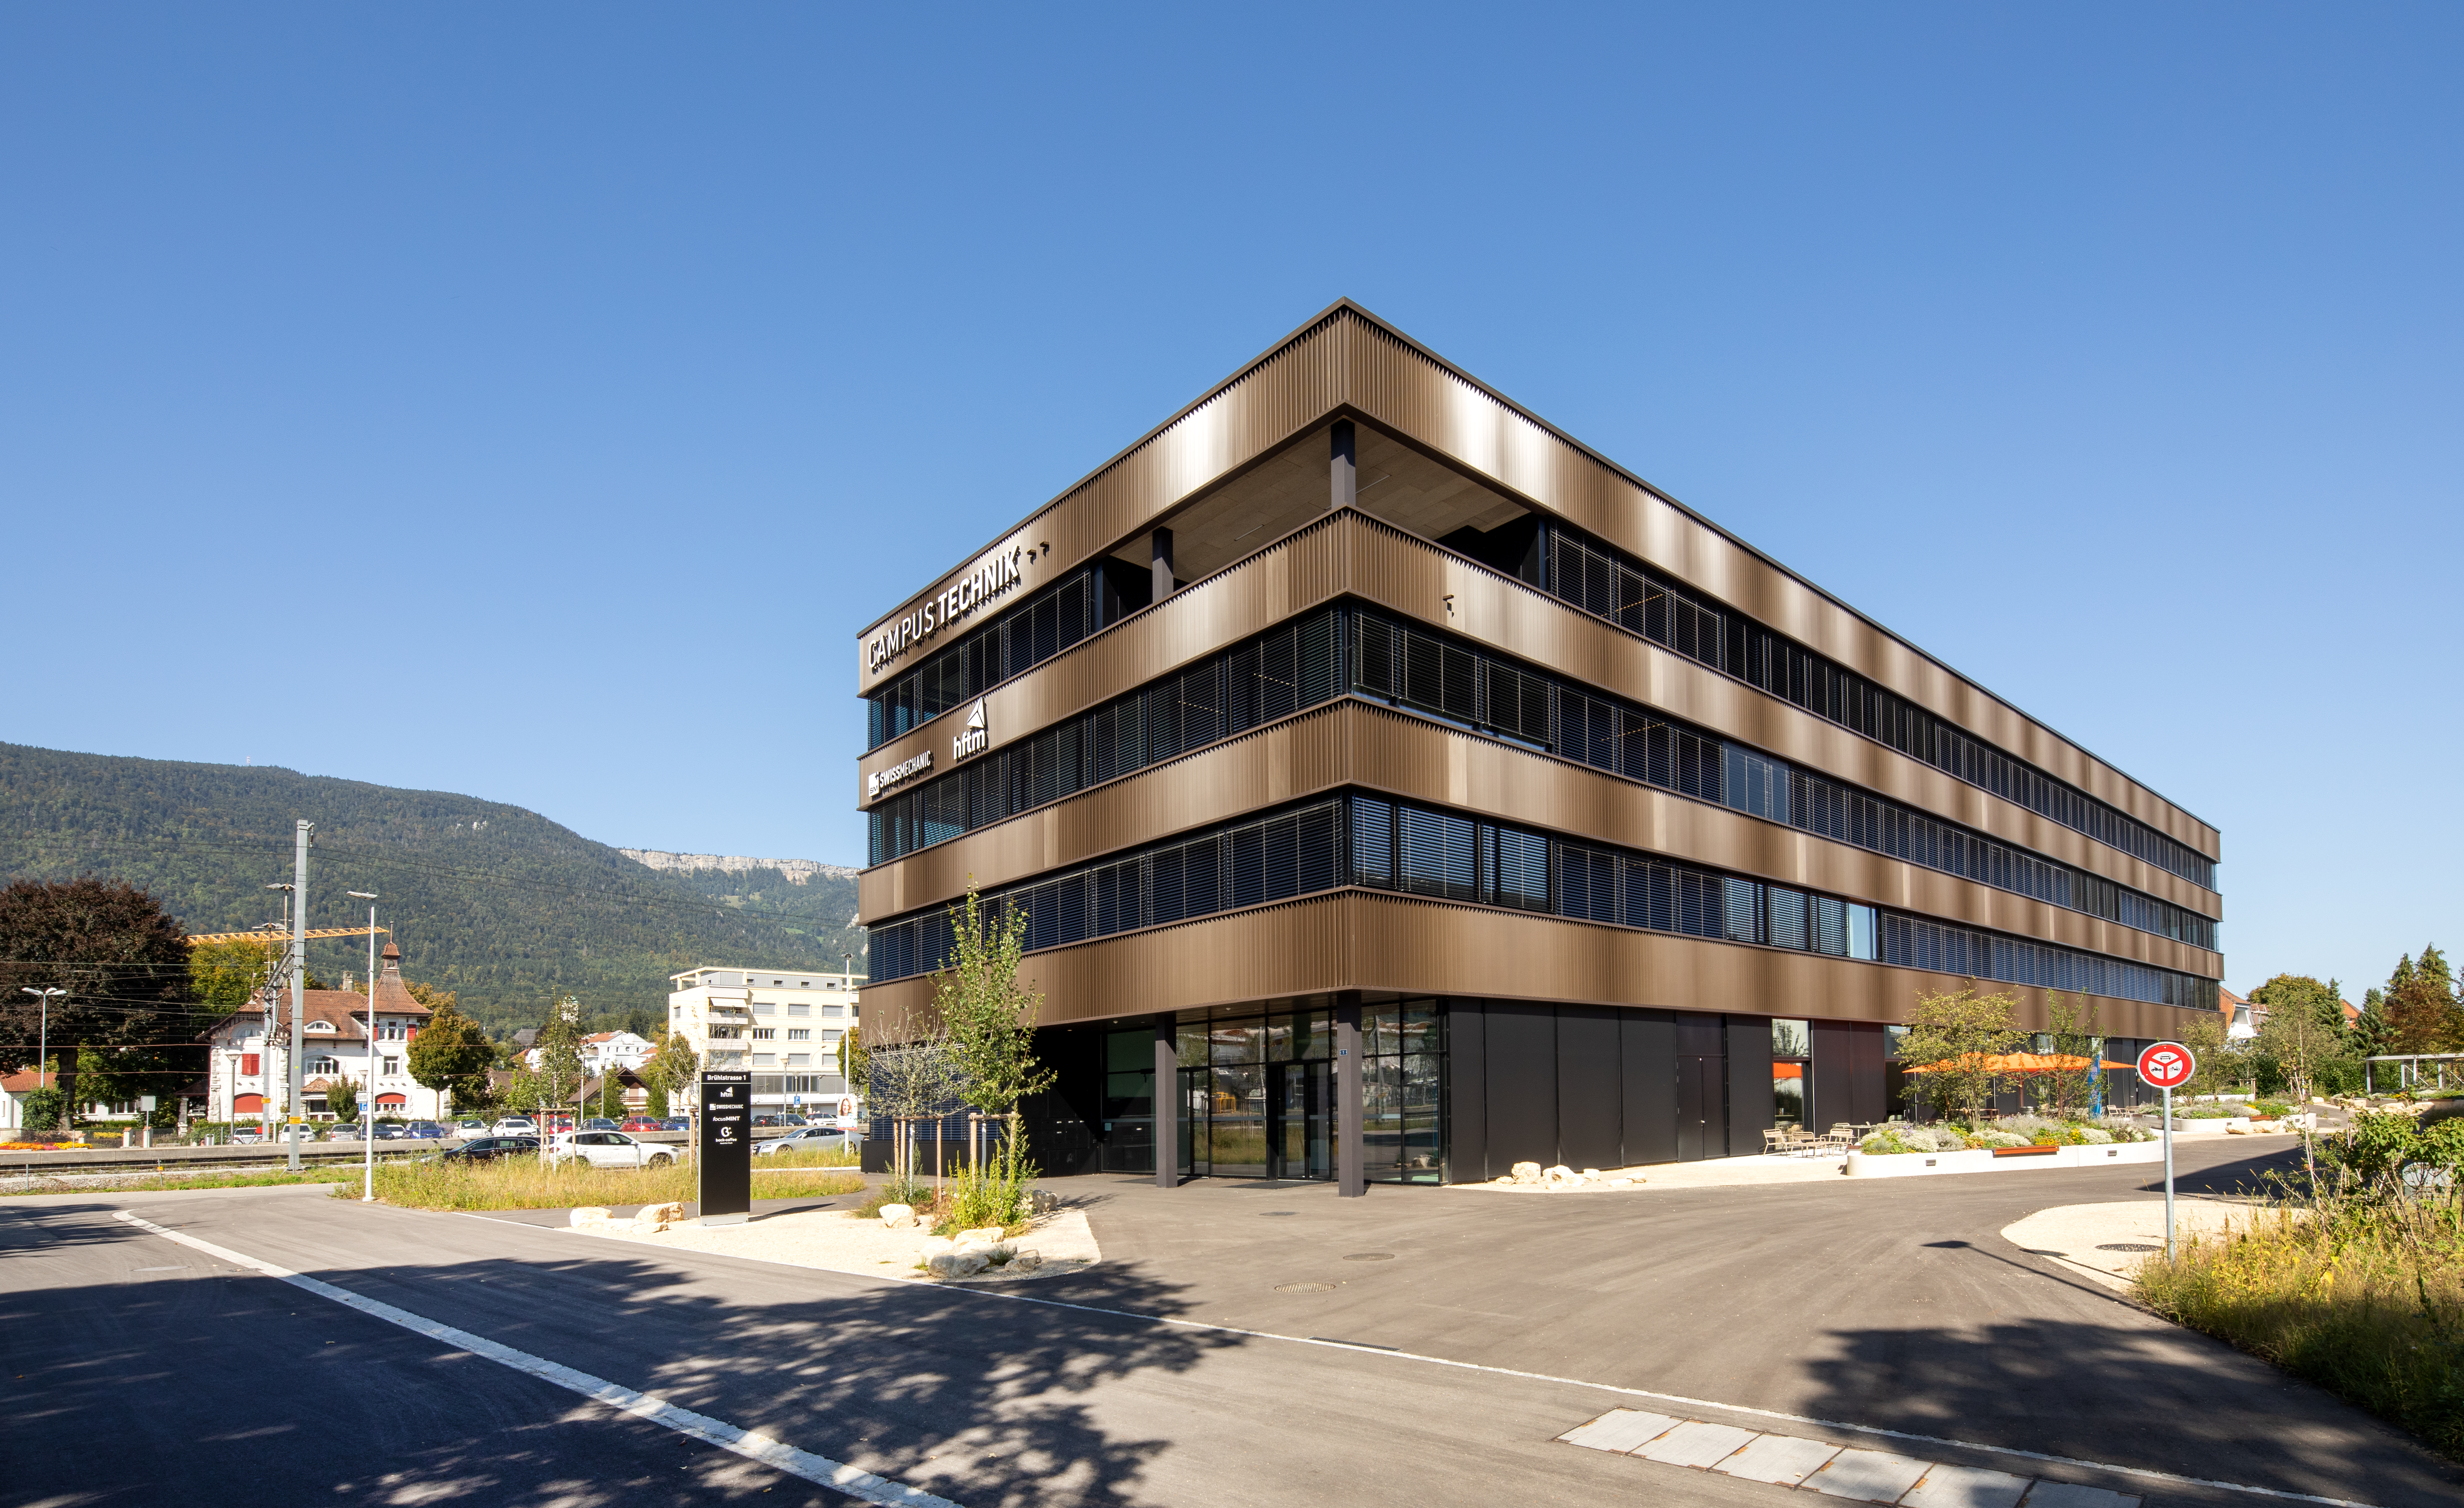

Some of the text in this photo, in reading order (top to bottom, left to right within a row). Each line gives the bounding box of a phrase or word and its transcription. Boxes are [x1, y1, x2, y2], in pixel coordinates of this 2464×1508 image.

[954, 729, 985, 760] hftm
[869, 750, 931, 794] SM SWISSMECHANIC
